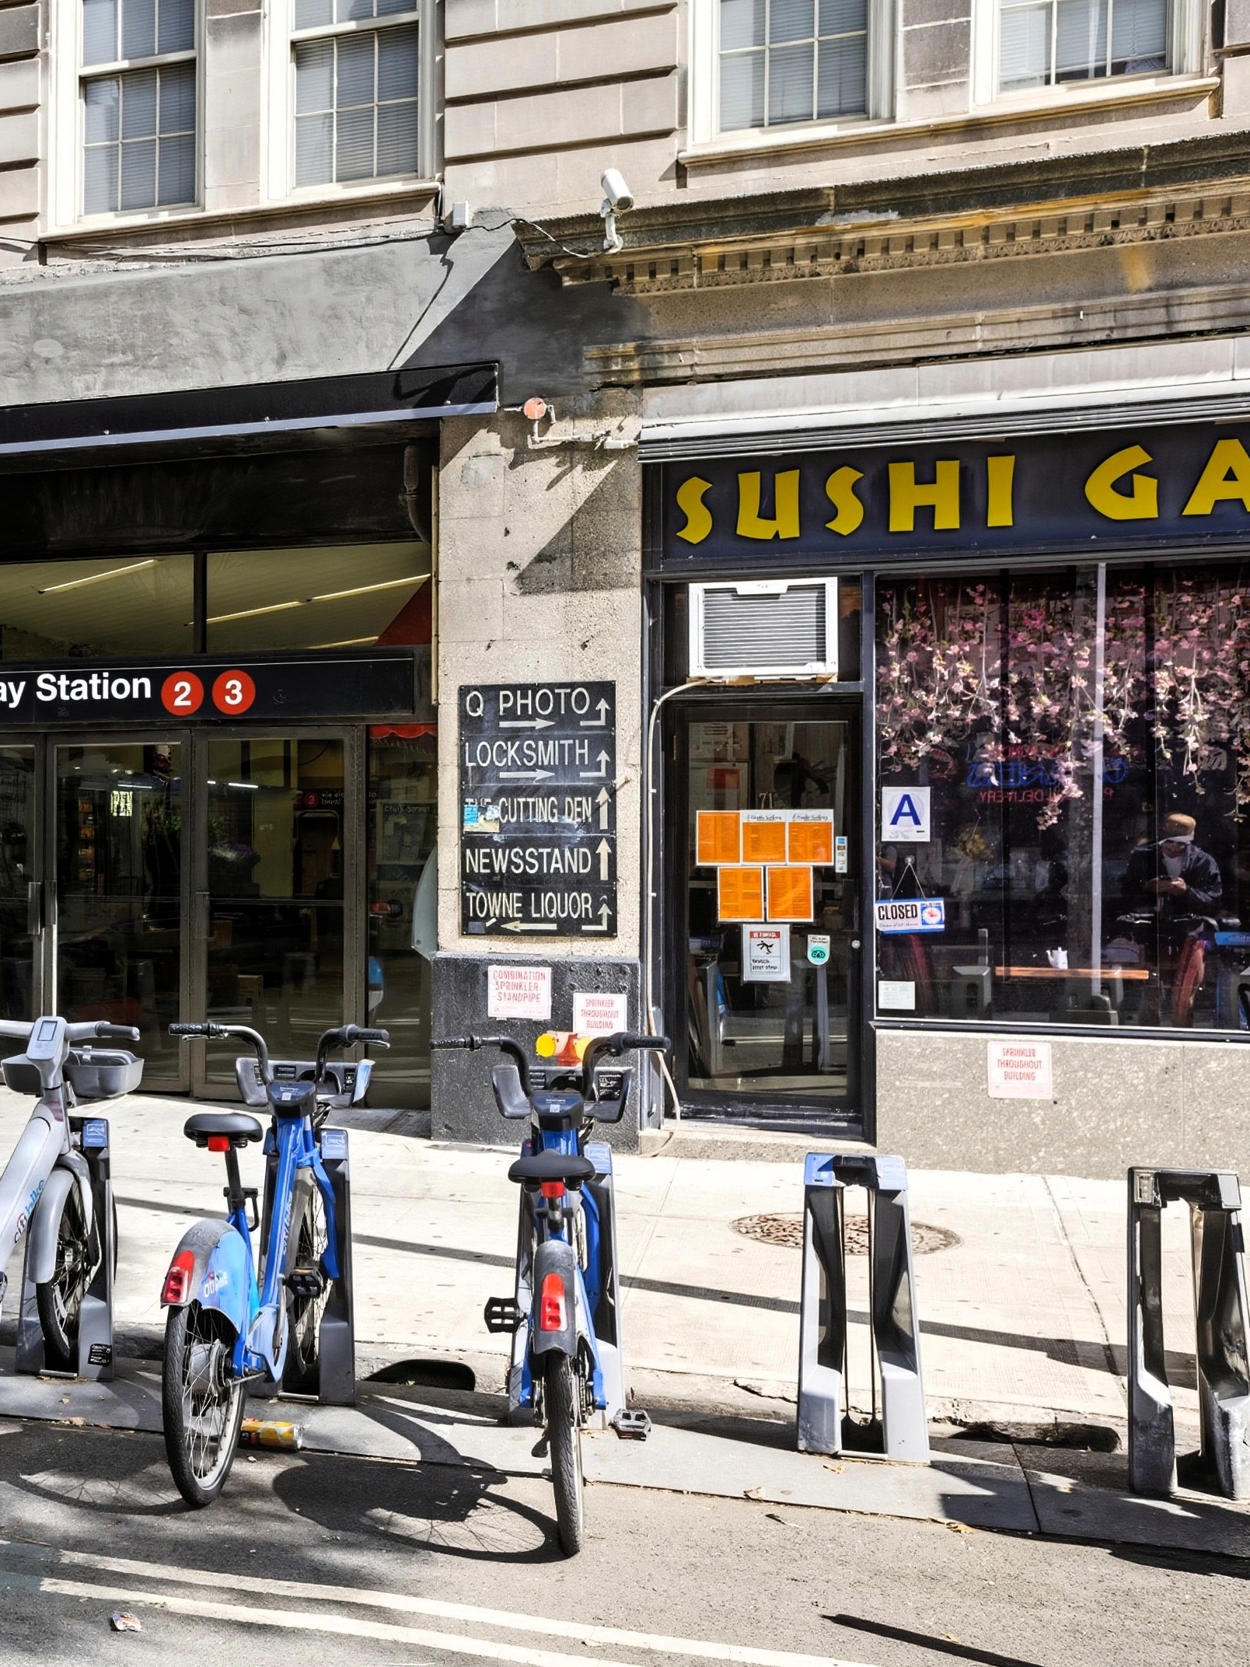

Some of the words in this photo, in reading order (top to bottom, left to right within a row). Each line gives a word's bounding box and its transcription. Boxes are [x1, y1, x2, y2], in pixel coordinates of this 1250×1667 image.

[676, 454, 1016, 545] SUSHI
[1084, 438, 1250, 521] GA
[35, 671, 152, 701] Station
[173, 680, 192, 707] 2
[224, 678, 243, 705] 3
[465, 690, 485, 717] Q
[500, 688, 591, 715] PHOTO
[465, 739, 589, 767] LOCKSMITH
[499, 797, 558, 823] CUTTING
[564, 797, 593, 823] DEN
[889, 793, 922, 826] A
[465, 847, 592, 874] NEWSSTAND
[466, 892, 523, 918] TOWNE
[530, 891, 593, 918] LIQUOR
[878, 904, 918, 920] CLOSED
[493, 969, 546, 982] COMBINATION
[497, 991, 541, 1003] STANDPIPE
[997, 1059, 1042, 1069] THROUGHOUT
[1002, 1048, 1036, 1058] SPRINKLER
[1004, 1071, 1036, 1081] BUILDING
